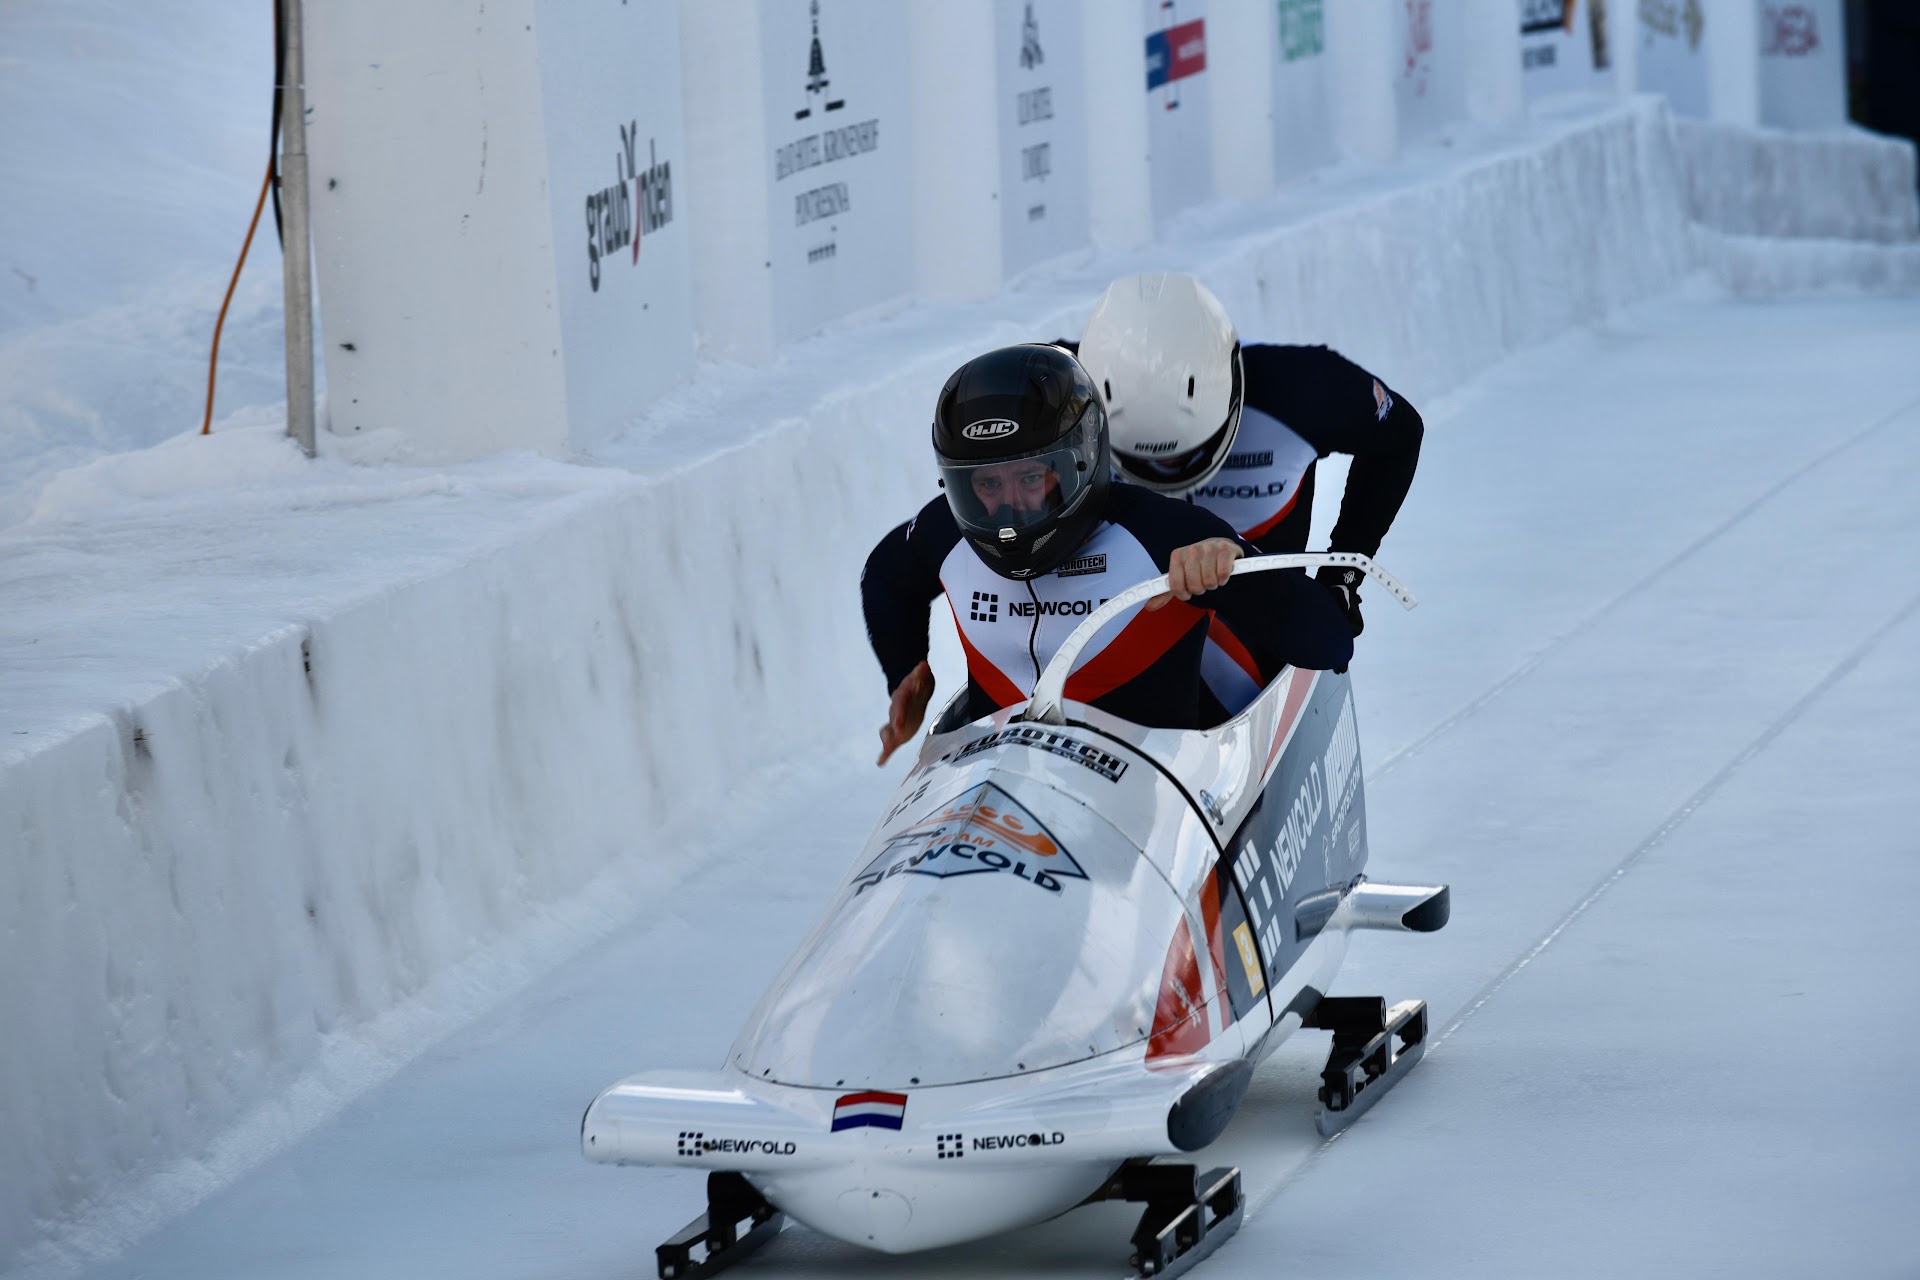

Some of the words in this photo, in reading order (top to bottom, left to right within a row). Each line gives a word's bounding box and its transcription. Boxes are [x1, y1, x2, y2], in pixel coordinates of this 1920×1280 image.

[969, 422, 1012, 437] HJC
[1009, 598, 1109, 617] NEWCOL
[961, 728, 1122, 772] EUROTECH
[1269, 760, 1323, 901] NEWCOLD
[854, 843, 1063, 898] NEWCOLD
[972, 1131, 1065, 1151] NEWCLD
